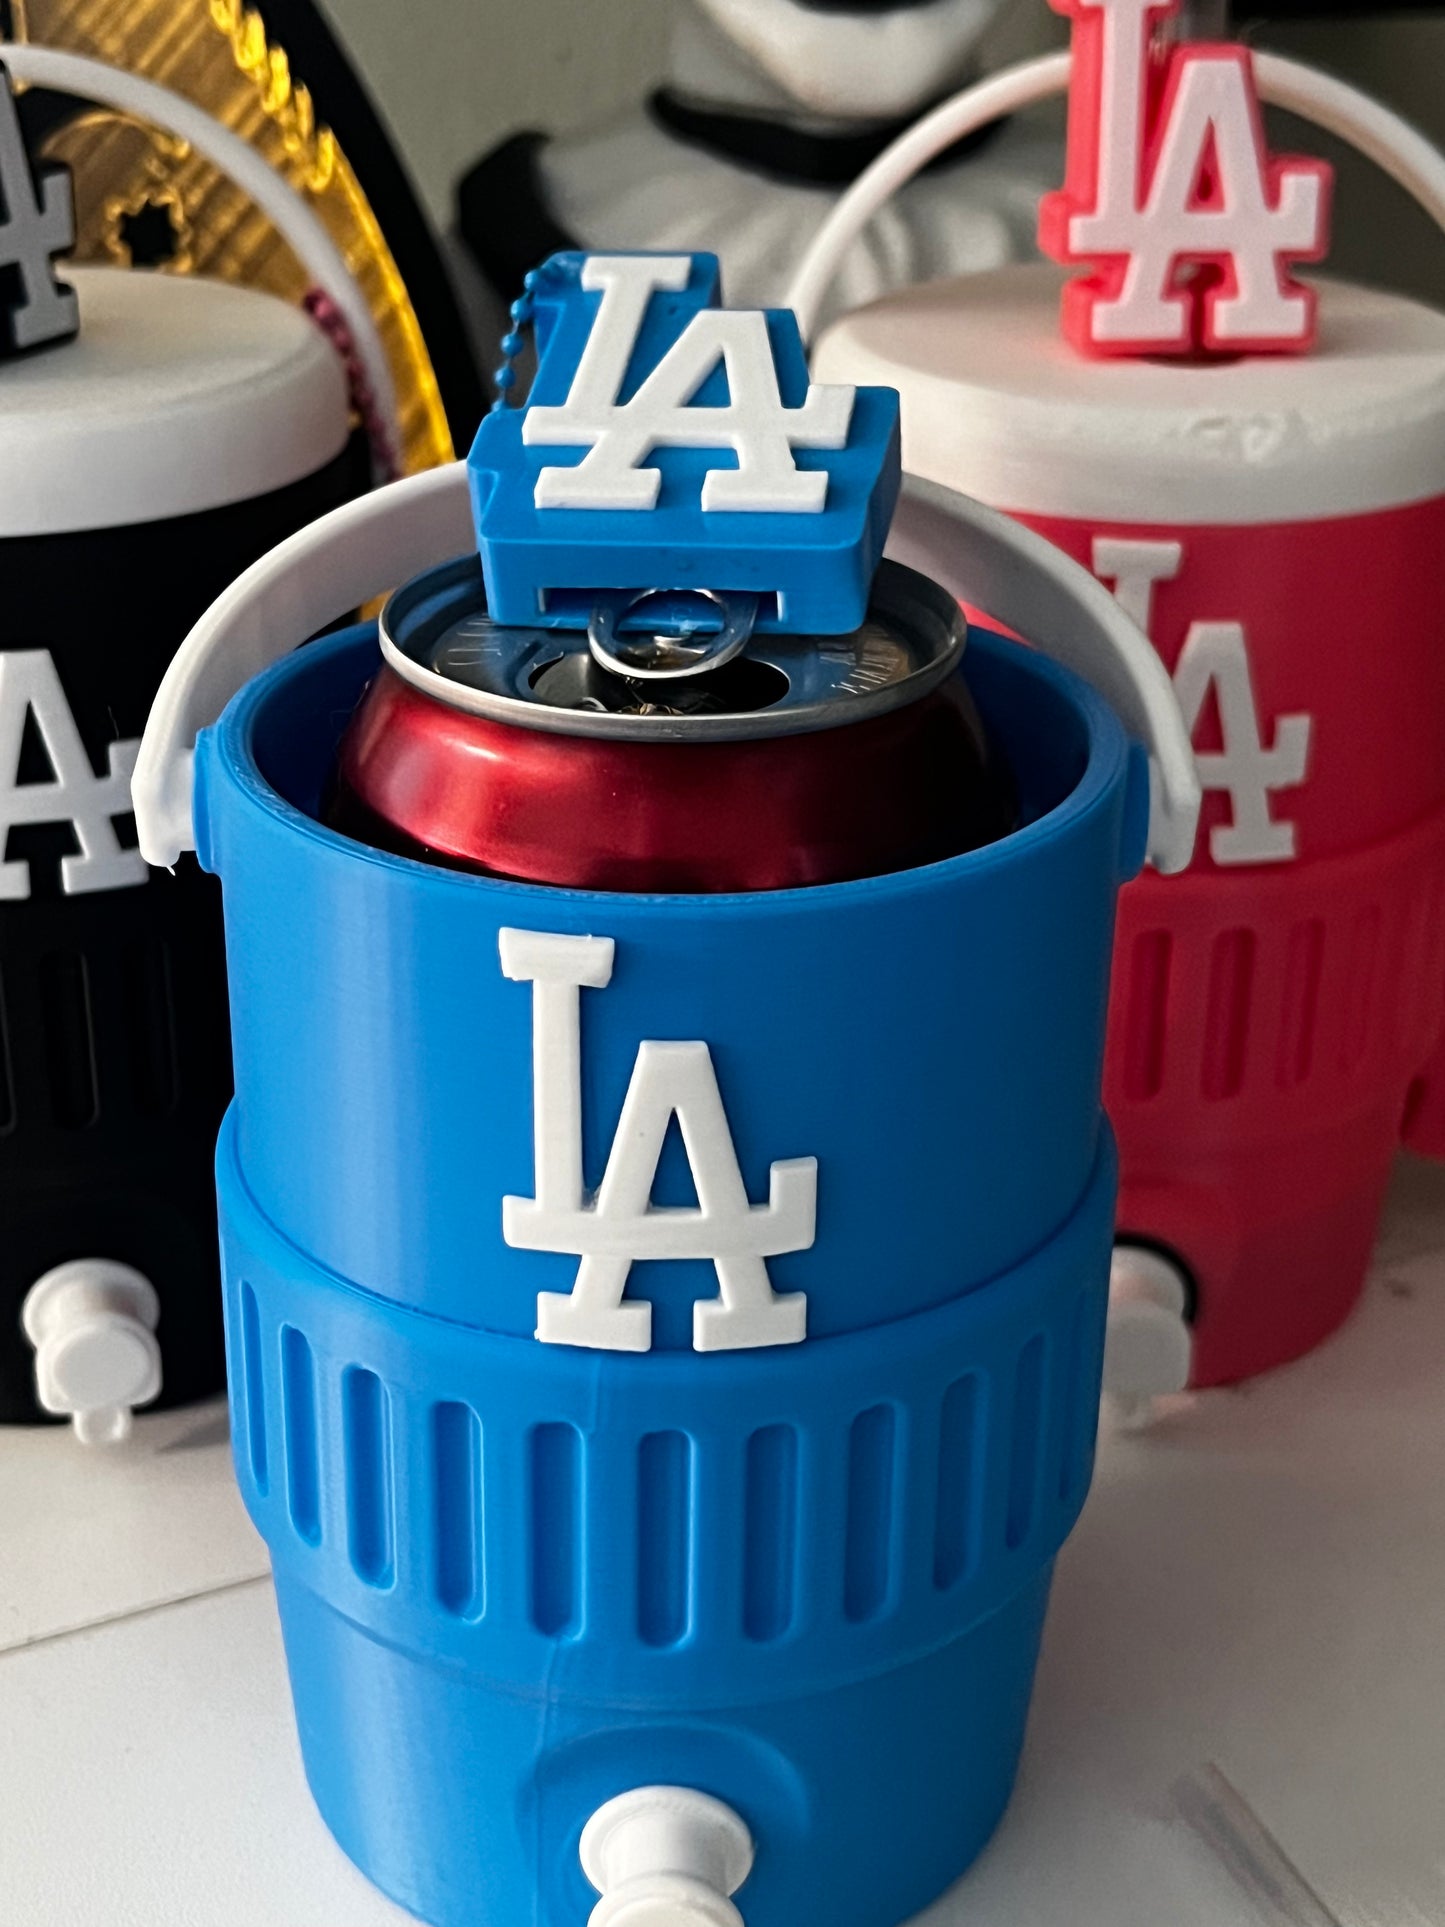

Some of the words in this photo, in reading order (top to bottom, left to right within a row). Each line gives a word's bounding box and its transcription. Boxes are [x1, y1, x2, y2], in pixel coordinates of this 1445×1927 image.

[1069, 0, 1321, 341] LA
[522, 256, 856, 513] LA
[0, 647, 150, 901] A
[498, 926, 818, 1353] LA
